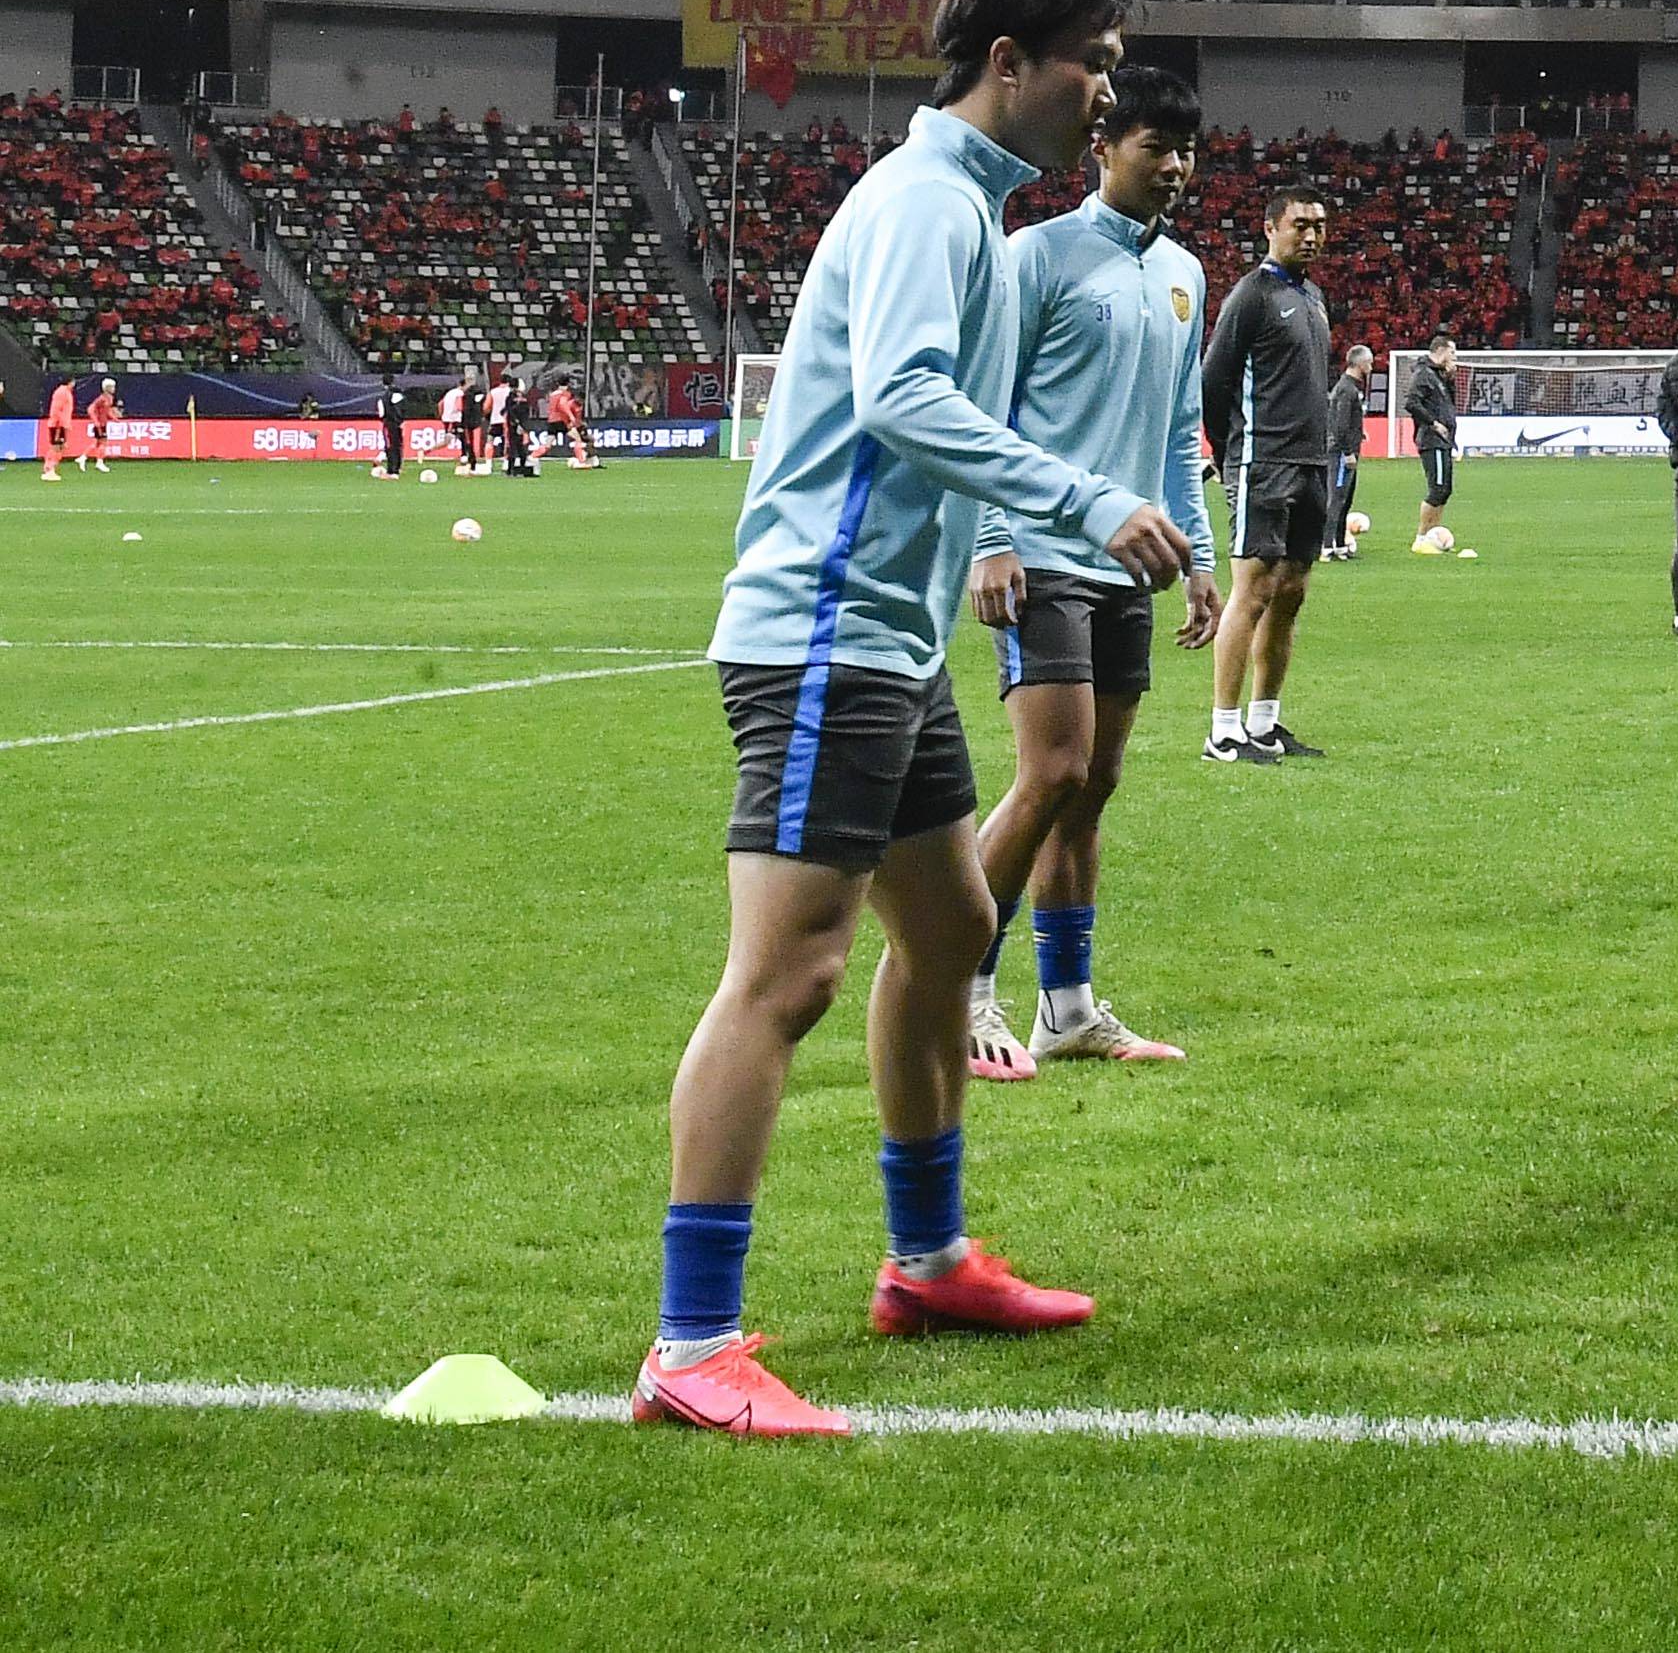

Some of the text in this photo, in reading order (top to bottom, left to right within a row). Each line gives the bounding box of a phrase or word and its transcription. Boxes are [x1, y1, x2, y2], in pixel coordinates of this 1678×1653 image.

[836, 25, 938, 60] TEA
[683, 371, 723, 412] 恒
[332, 428, 385, 451] 58同
